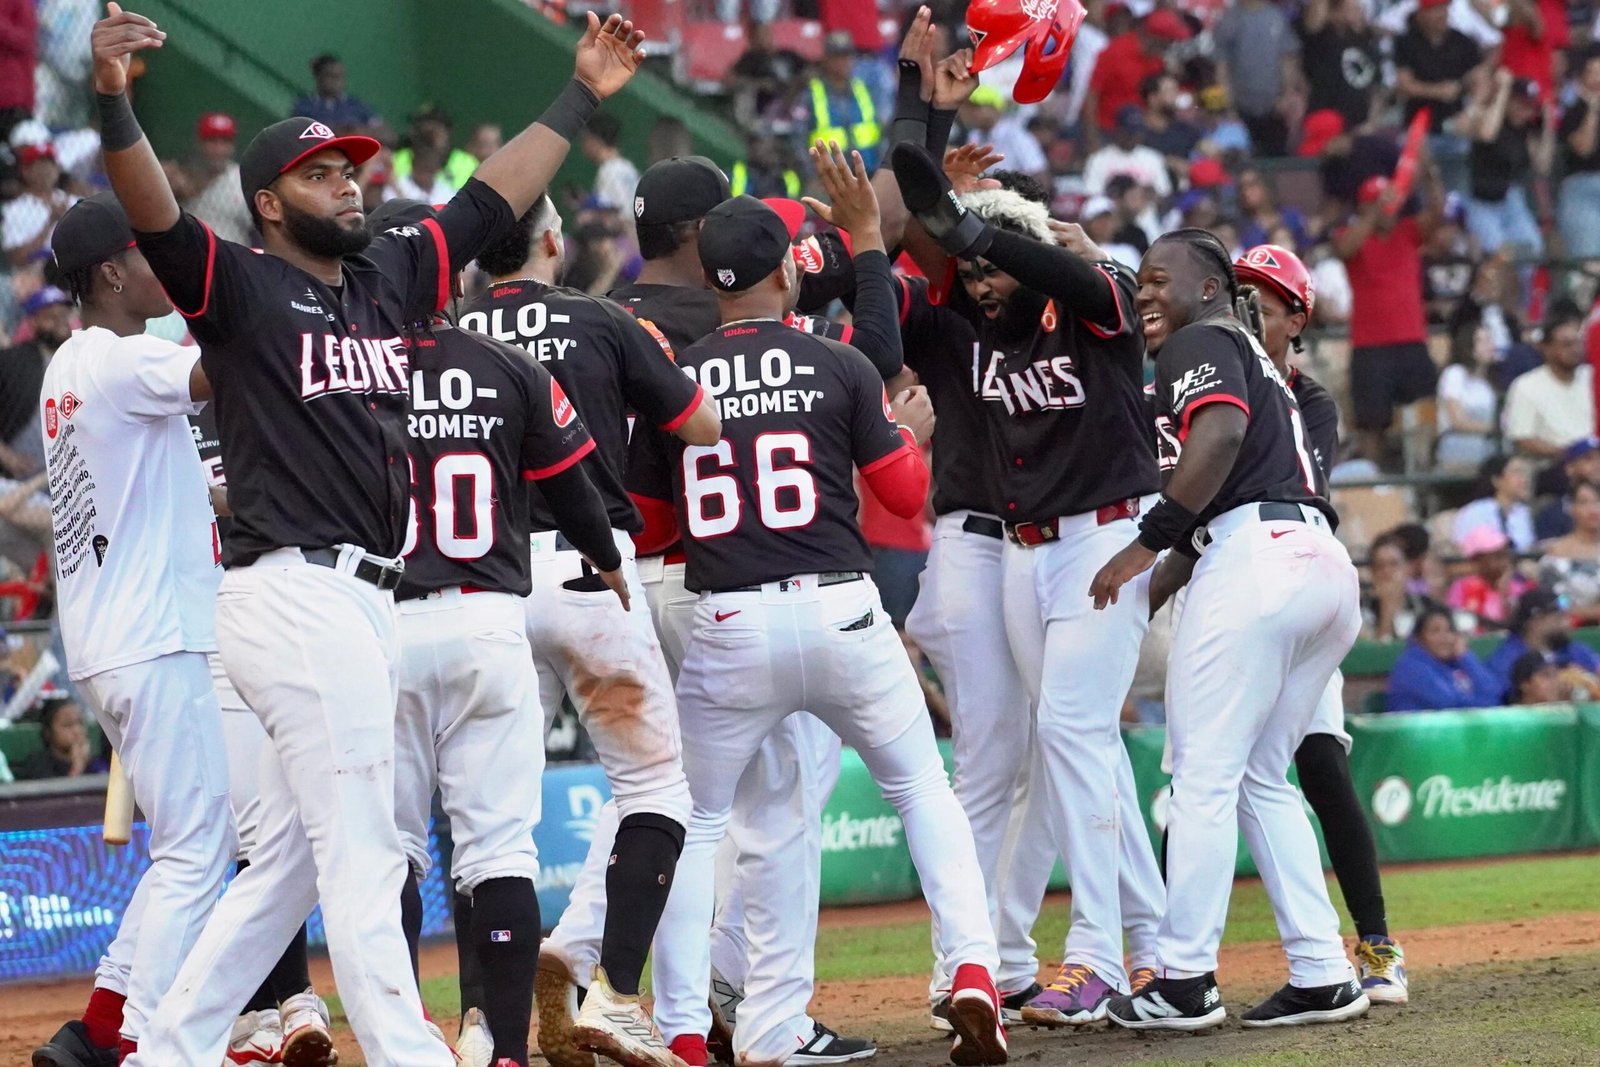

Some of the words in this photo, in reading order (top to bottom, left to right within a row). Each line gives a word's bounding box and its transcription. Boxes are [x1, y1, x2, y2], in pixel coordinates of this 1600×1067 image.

[1250, 250, 1267, 264] E
[493, 286, 522, 299] Wilson
[723, 326, 758, 338] Wilson
[682, 431, 820, 540] 66
[1416, 774, 1567, 819] Presidente
